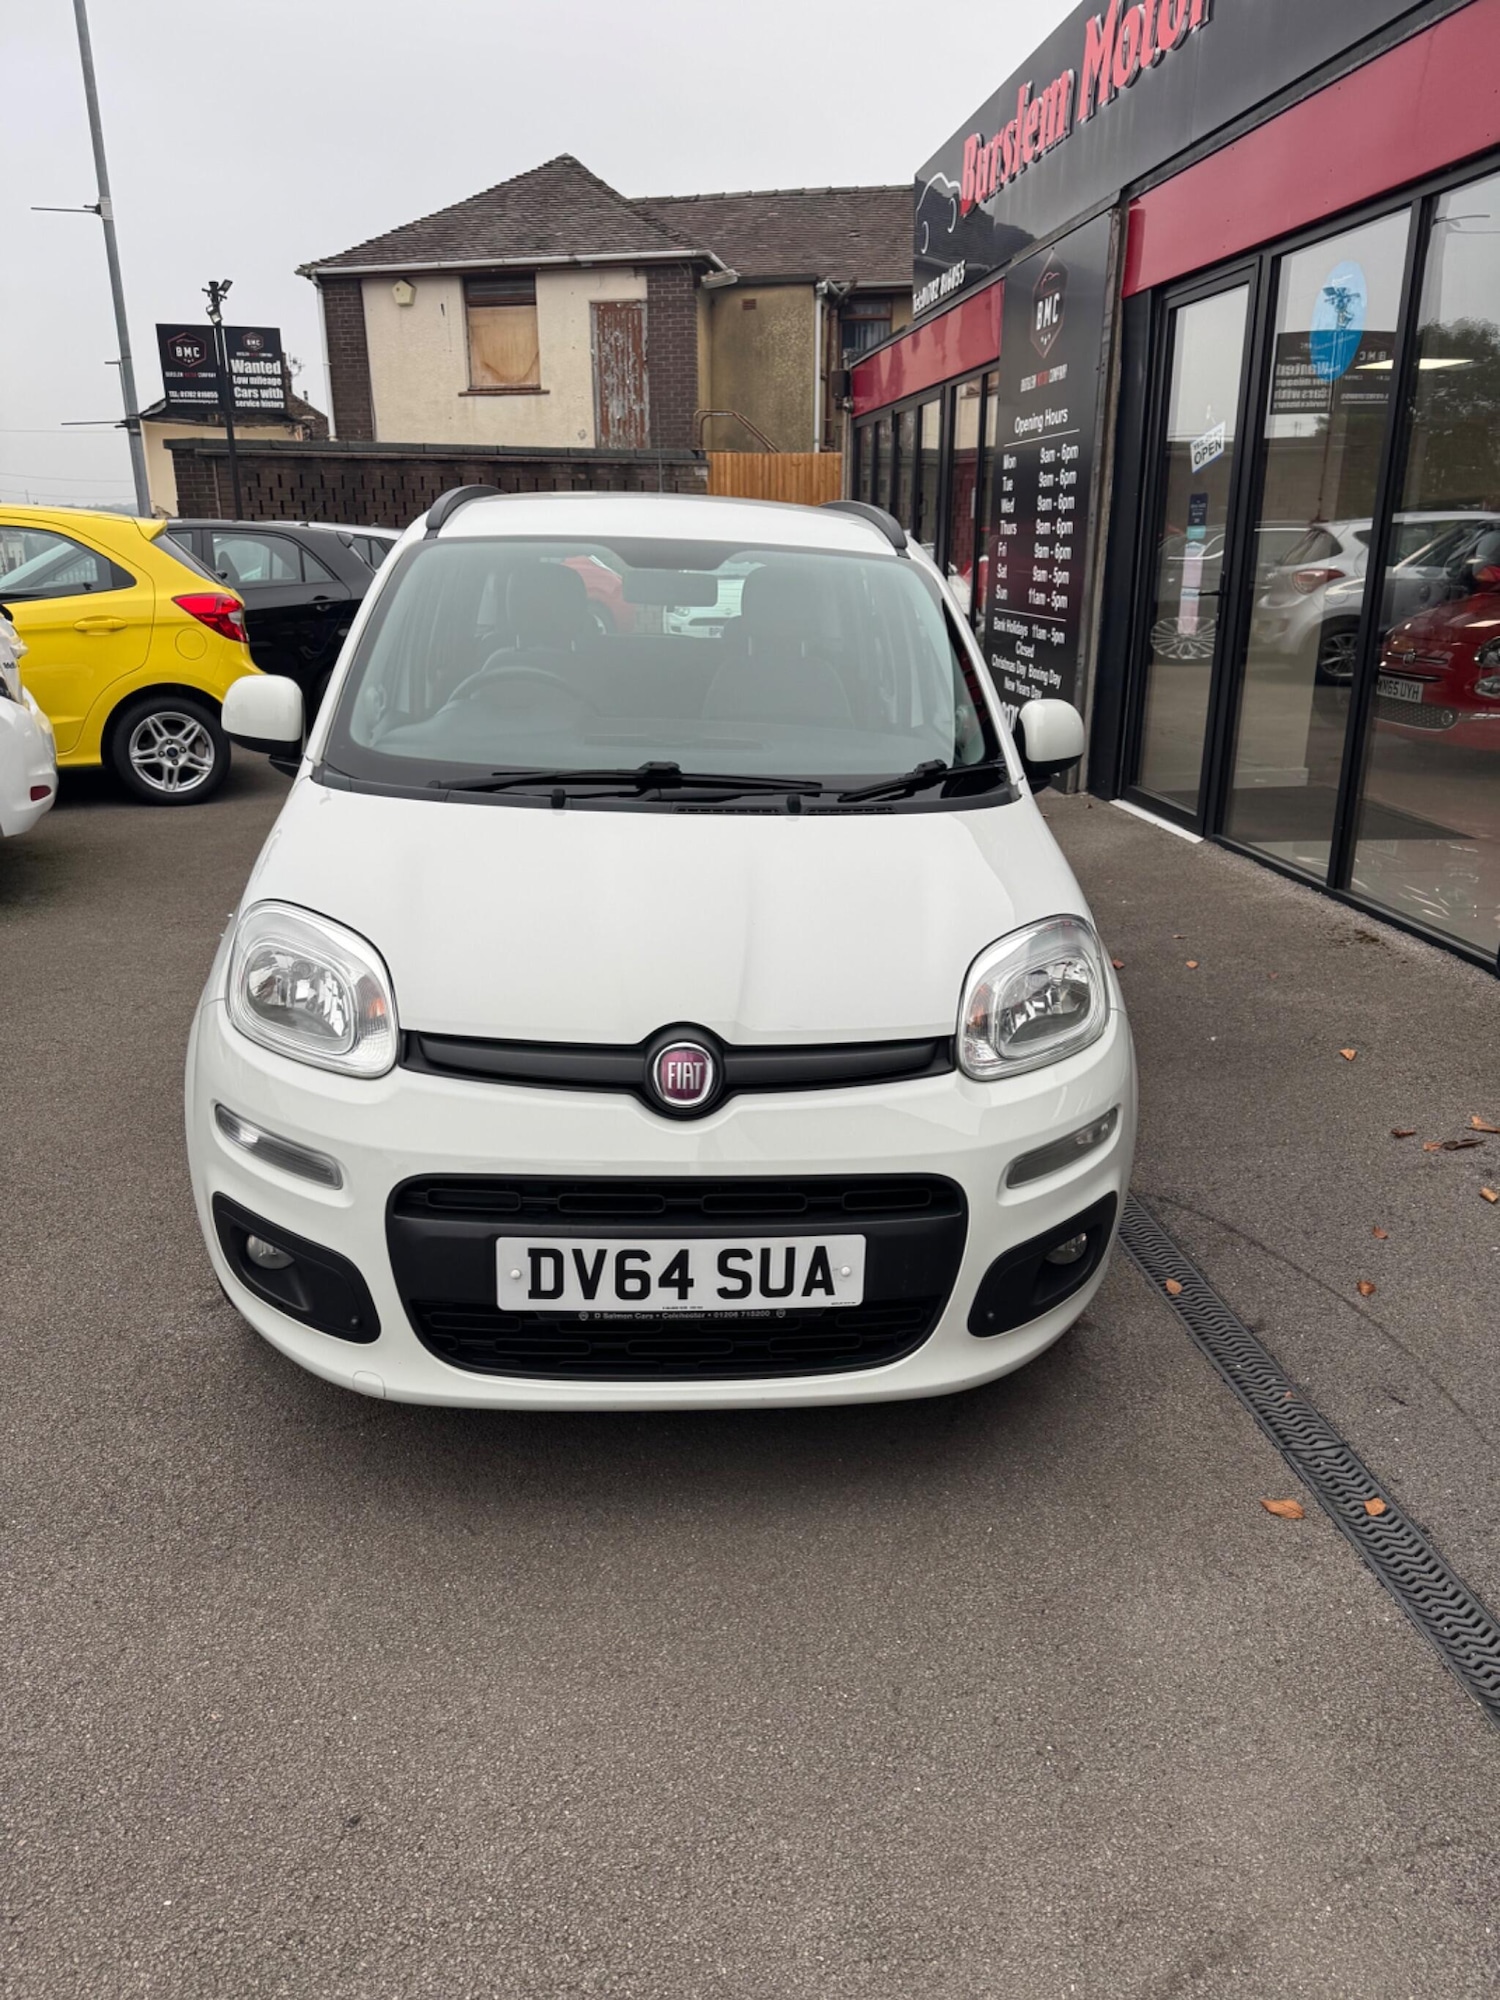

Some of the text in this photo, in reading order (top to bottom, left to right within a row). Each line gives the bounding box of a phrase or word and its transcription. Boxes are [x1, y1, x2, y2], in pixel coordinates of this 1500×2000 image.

[960, 69, 1073, 216] Burslem
[1036, 292, 1060, 331] BMC
[176, 346, 200, 358] BMC
[230, 359, 282, 375] Wanted
[232, 375, 282, 386] Low mileage
[234, 386, 284, 399] Cars with
[261, 400, 285, 408] history
[1014, 408, 1068, 437] Opening Hours
[1003, 454, 1017, 470] Mon
[1040, 448, 1055, 464] 9am
[1061, 443, 1079, 464] 6pm
[1194, 440, 1221, 465] OPEN
[1002, 477, 1013, 491] Tue
[1038, 472, 1054, 488] 9am
[1060, 468, 1077, 490] 6pm
[1001, 498, 1014, 513] Wed
[1037, 495, 1052, 511] 9am
[1058, 493, 1075, 514] 6pm
[1000, 520, 1017, 535] Thurs
[1036, 518, 1050, 535] 9am
[1056, 518, 1073, 538] 6pm
[998, 542, 1007, 557] Fri
[1034, 542, 1049, 559] 9am
[1054, 542, 1072, 563] 6pm
[996, 563, 1007, 578] Sat
[1032, 566, 1048, 582] 9am
[1053, 566, 1070, 588] 5pm
[995, 585, 1007, 600] Sun
[1028, 588, 1046, 605] 11am
[1051, 590, 1068, 611] 5pm
[993, 616, 1006, 632] Bank
[1006, 619, 1028, 639] Holidays
[1032, 624, 1046, 640] 11am
[1051, 627, 1065, 646] 5pm
[1015, 640, 1035, 658] Closed
[992, 654, 1062, 689] Christmas Day Boxing Day
[1004, 676, 1015, 692] New
[1016, 680, 1030, 697] Years
[1400, 682, 1420, 700] UYH
[668, 1062, 703, 1090] FIAT
[527, 1245, 836, 1300] DV64 SUA
